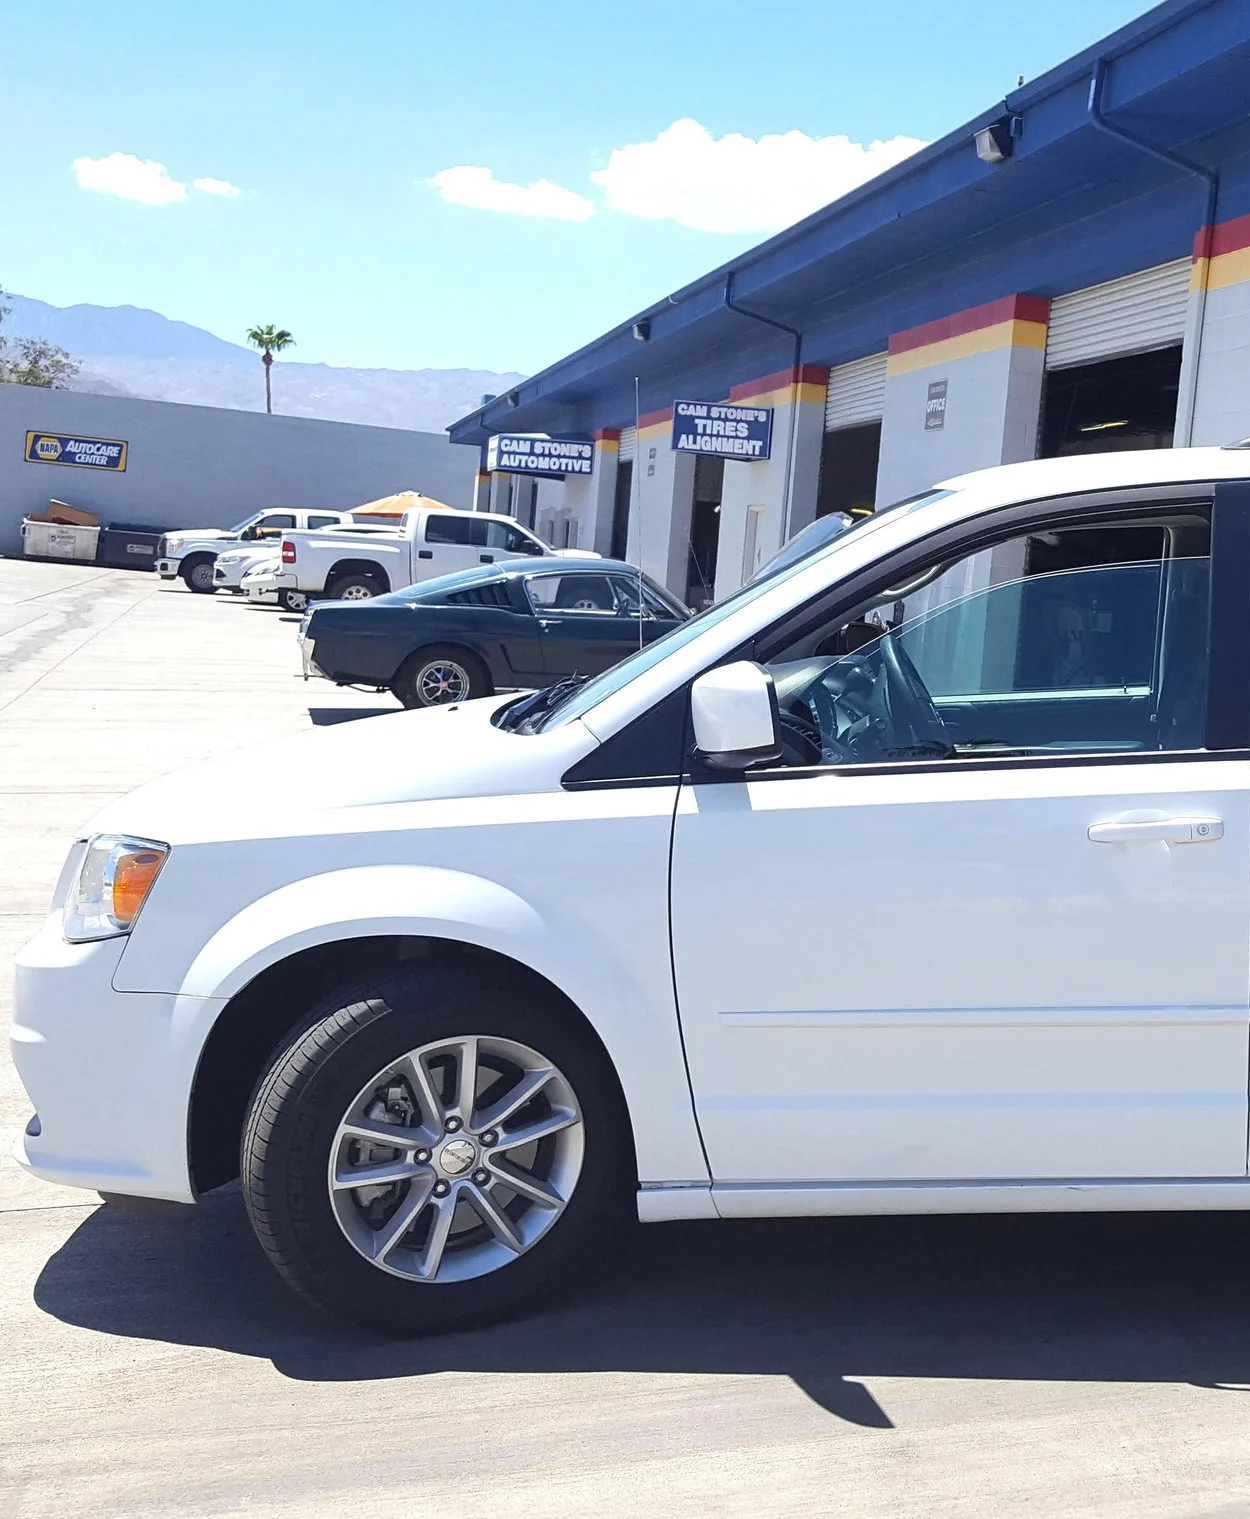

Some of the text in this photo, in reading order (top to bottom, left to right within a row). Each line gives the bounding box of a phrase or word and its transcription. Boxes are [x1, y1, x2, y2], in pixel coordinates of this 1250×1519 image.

[677, 403, 767, 422] CAM STONE'S
[926, 397, 946, 413] OFFICE
[694, 418, 749, 438] TIRES
[40, 442, 59, 455] NAPA
[500, 439, 592, 458] CAM STONE'S
[677, 433, 763, 455] ALIGNMENT
[75, 453, 108, 465] CENTER
[500, 454, 591, 473] AUTOMOTIVE
